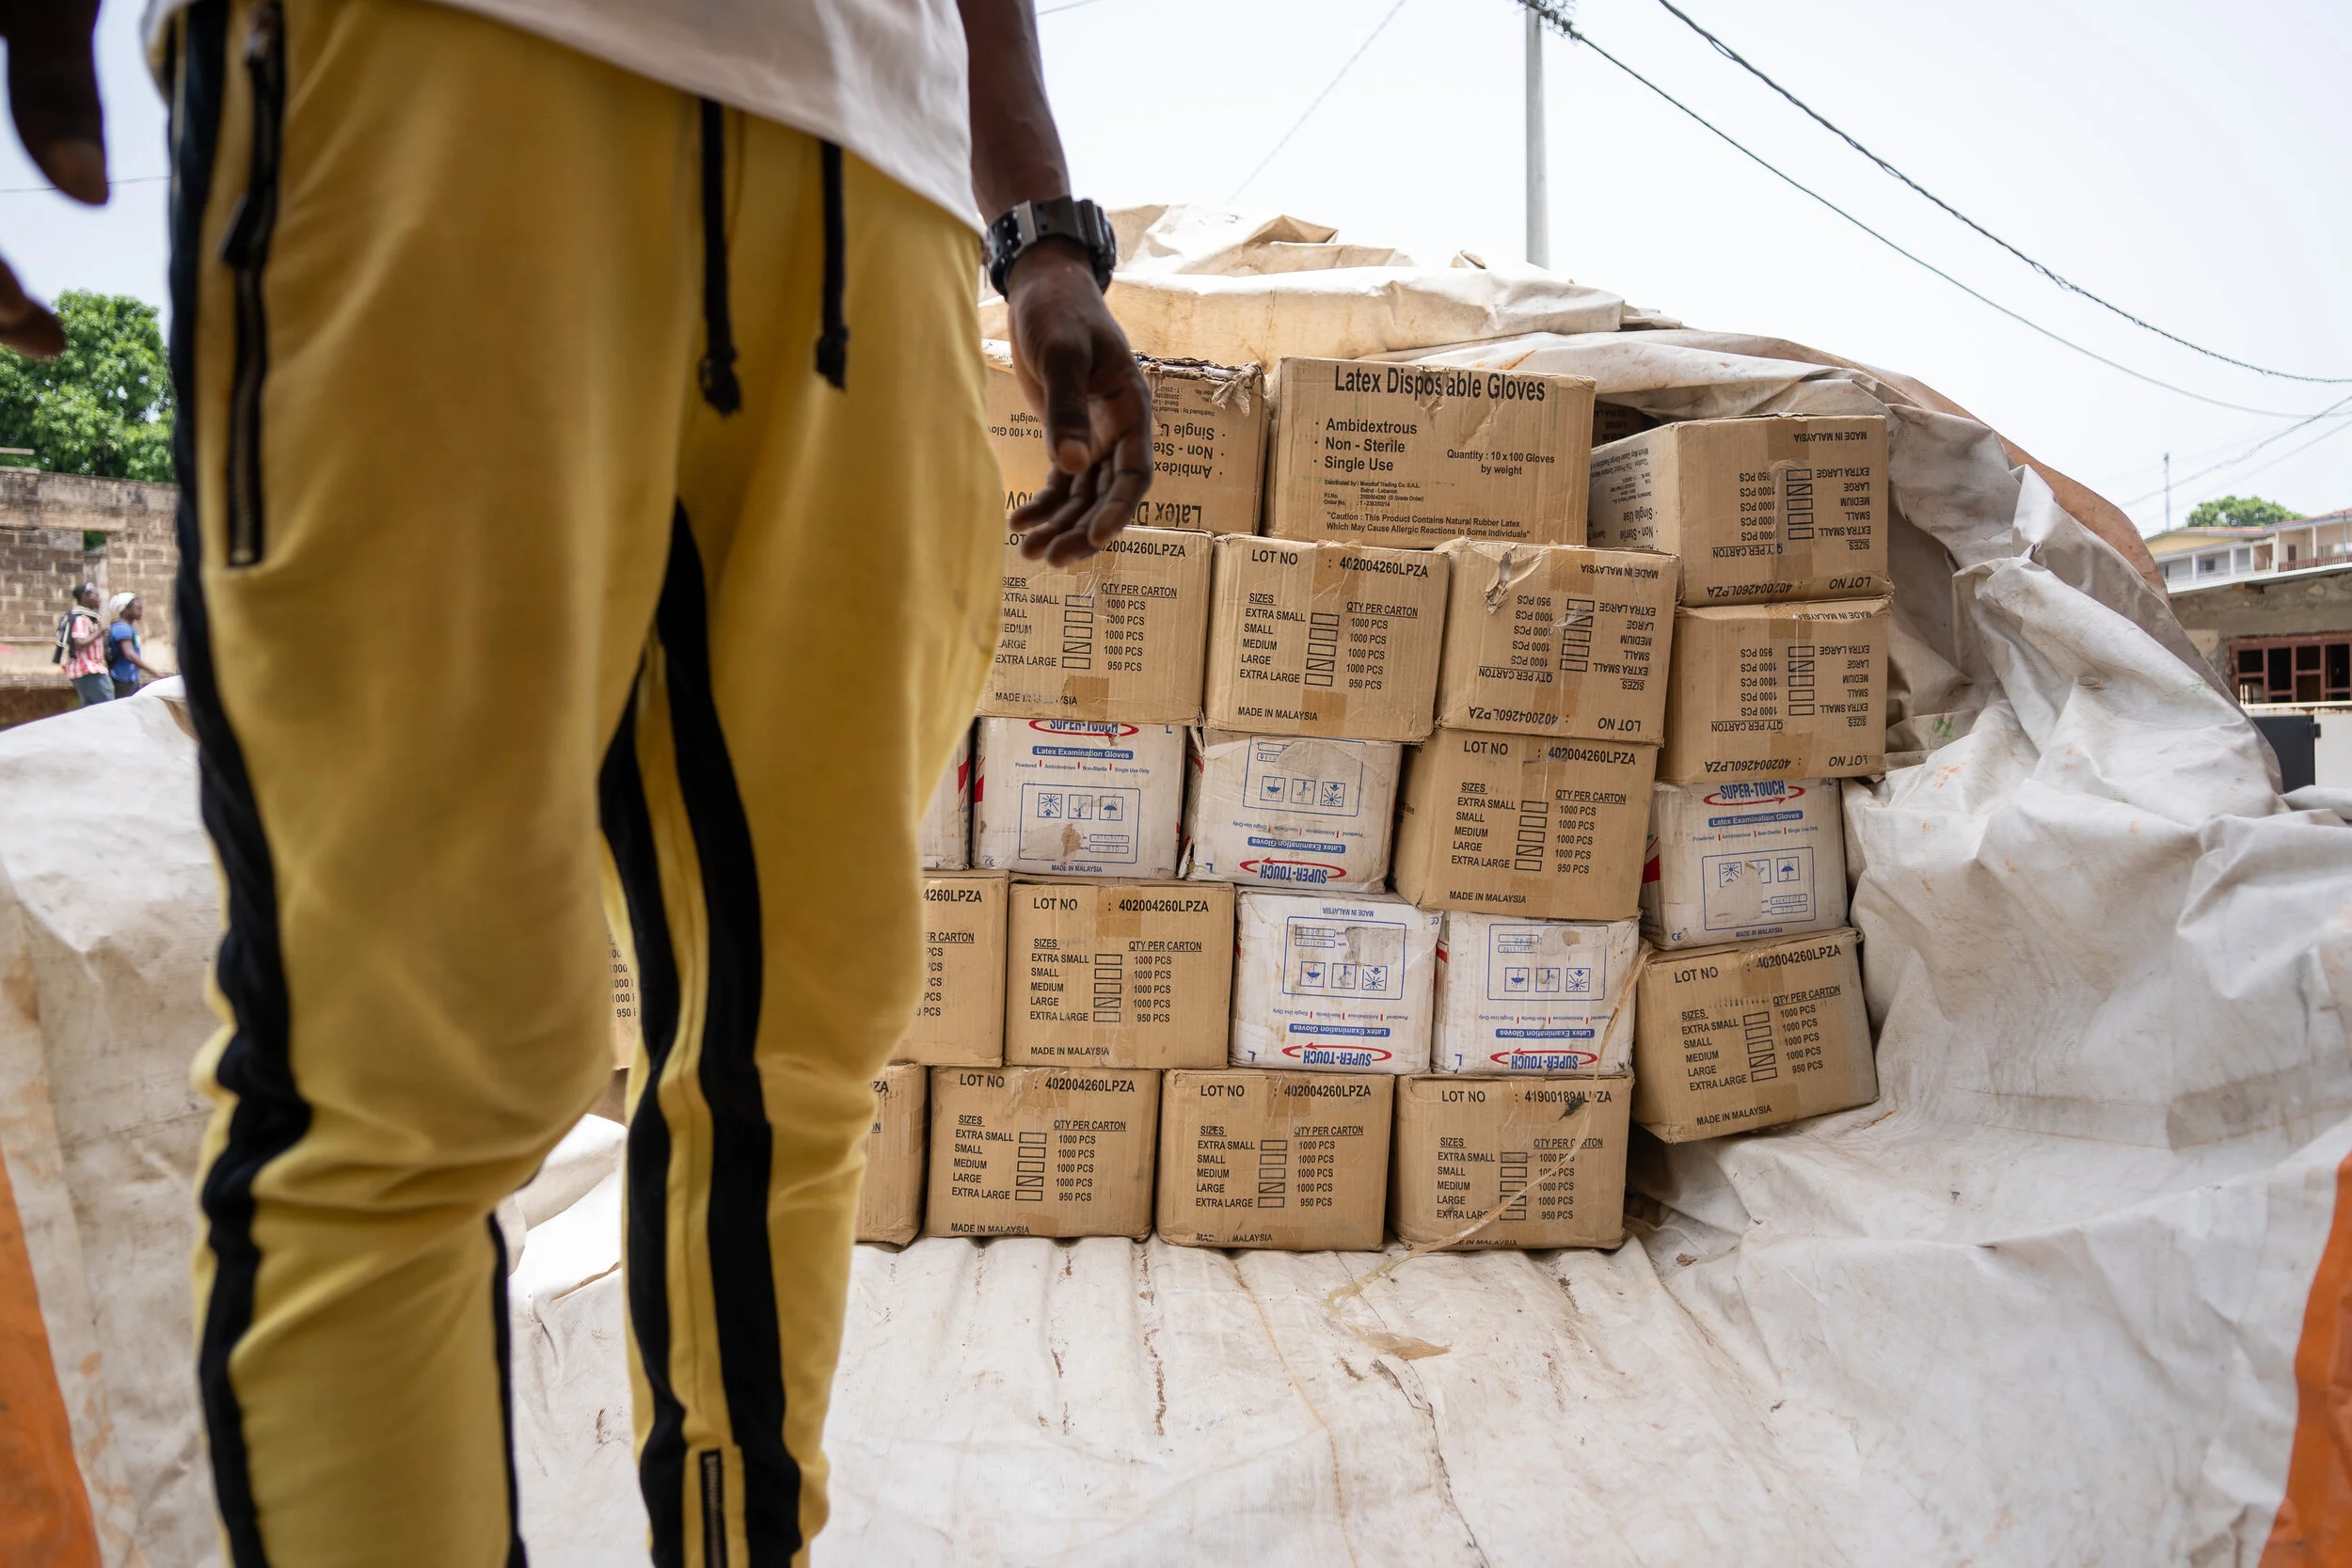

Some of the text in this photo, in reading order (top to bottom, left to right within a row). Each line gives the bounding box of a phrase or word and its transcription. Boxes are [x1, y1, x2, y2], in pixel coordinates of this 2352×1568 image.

[1335, 366, 1546, 402] Latex Disposable Gloves
[1326, 418, 1417, 435] Ambidextrous
[1009, 428, 1025, 437] 100
[1794, 431, 1867, 442] MADE IN MALAYSIA
[1326, 437, 1406, 452] Non Sterile
[1187, 446, 1213, 459] Non
[1447, 449, 1484, 461] Quantity
[1491, 451, 1501, 461] 10
[1508, 452, 1523, 462] 100
[1526, 453, 1555, 464] Gloves
[1325, 456, 1393, 471] Single Use
[1481, 465, 1522, 476] by weight
[1844, 482, 1869, 491] LARGE
[1382, 515, 1410, 523] Product
[1412, 515, 1443, 524] Contains
[1446, 517, 1471, 526] Natural
[1473, 518, 1499, 527] Rubber
[1501, 519, 1519, 528] Latex
[1327, 522, 1348, 531] Which
[1351, 523, 1364, 532] May
[1367, 524, 1389, 532] Cause
[1391, 526, 1418, 534] Allergic
[1421, 527, 1455, 535] Reactions
[1850, 540, 1870, 550] SIZES
[1252, 549, 1428, 578] LOT NO 402004260LPZA
[1581, 564, 1658, 578] MADE IN MALAYSIA
[1102, 583, 1177, 596] QTY PER CARTON
[1246, 608, 1305, 622] EXTRA SMALL
[1351, 618, 1388, 629] 1000 PCS
[1243, 639, 1277, 650] MEDIUM
[1820, 645, 1869, 655] EXTRA LARGE
[1624, 651, 1650, 660] SMALL
[1740, 648, 1772, 657] 950 PCS
[995, 655, 1057, 666] EXTRA LARGE
[1349, 678, 1381, 689] 950 PCS
[1238, 706, 1317, 721] MADE IN MALAYSIA
[1598, 718, 1641, 732] LOT NO
[1058, 748, 1103, 757] Examination
[1464, 740, 1635, 765] LOT NO 402004260LPZA
[1705, 754, 1867, 772] LOT NO 402004260LPZA
[1721, 781, 1785, 799] SUPER-TOUCH
[1458, 797, 1516, 811] EXTRA SMALL
[1561, 805, 1596, 816] 1000 PCS
[1733, 815, 1774, 824] Examination
[1776, 812, 1799, 820] Gloves
[1279, 841, 1321, 850] Examination
[1454, 841, 1482, 851] LARGE
[1260, 864, 1327, 883] SUPER-TOUCH
[1034, 898, 1209, 912] LOT NO 402004260LPZA
[939, 932, 975, 942] CARTON
[1758, 927, 1783, 936] MALAYSIA
[1135, 956, 1171, 965] 1000 PCS
[1675, 944, 1841, 984] LOT NO 402004260LPZA
[1031, 968, 1058, 977] SMALL
[1031, 982, 1063, 991] MEDIUM
[1772, 986, 1841, 1006] QTY PER CARTON
[616, 1008, 631, 1017] 950
[924, 1007, 941, 1016] PCS
[1303, 1051, 1372, 1066] SUPER-TOUCH
[1511, 1054, 1579, 1069] SUPER-TOUCH
[960, 1074, 1135, 1092] LOT NO 402004260LPZA
[1200, 1085, 1371, 1097] LOT NO 402004260LPZA
[1442, 1091, 1465, 1102] LOT
[1469, 1091, 1486, 1102] NO
[1696, 1104, 1772, 1126] MADE IN MALAYSIA
[1054, 1120, 1126, 1130] QTY PER CARTON
[1440, 1137, 1464, 1147] SIZES
[954, 1159, 987, 1169] MEDIUM
[1438, 1166, 1466, 1177] SMALL
[1539, 1182, 1574, 1191] 1000 PCS
[1196, 1198, 1253, 1207] EXTRA LARGE
[1300, 1198, 1332, 1207] 950 PCS
